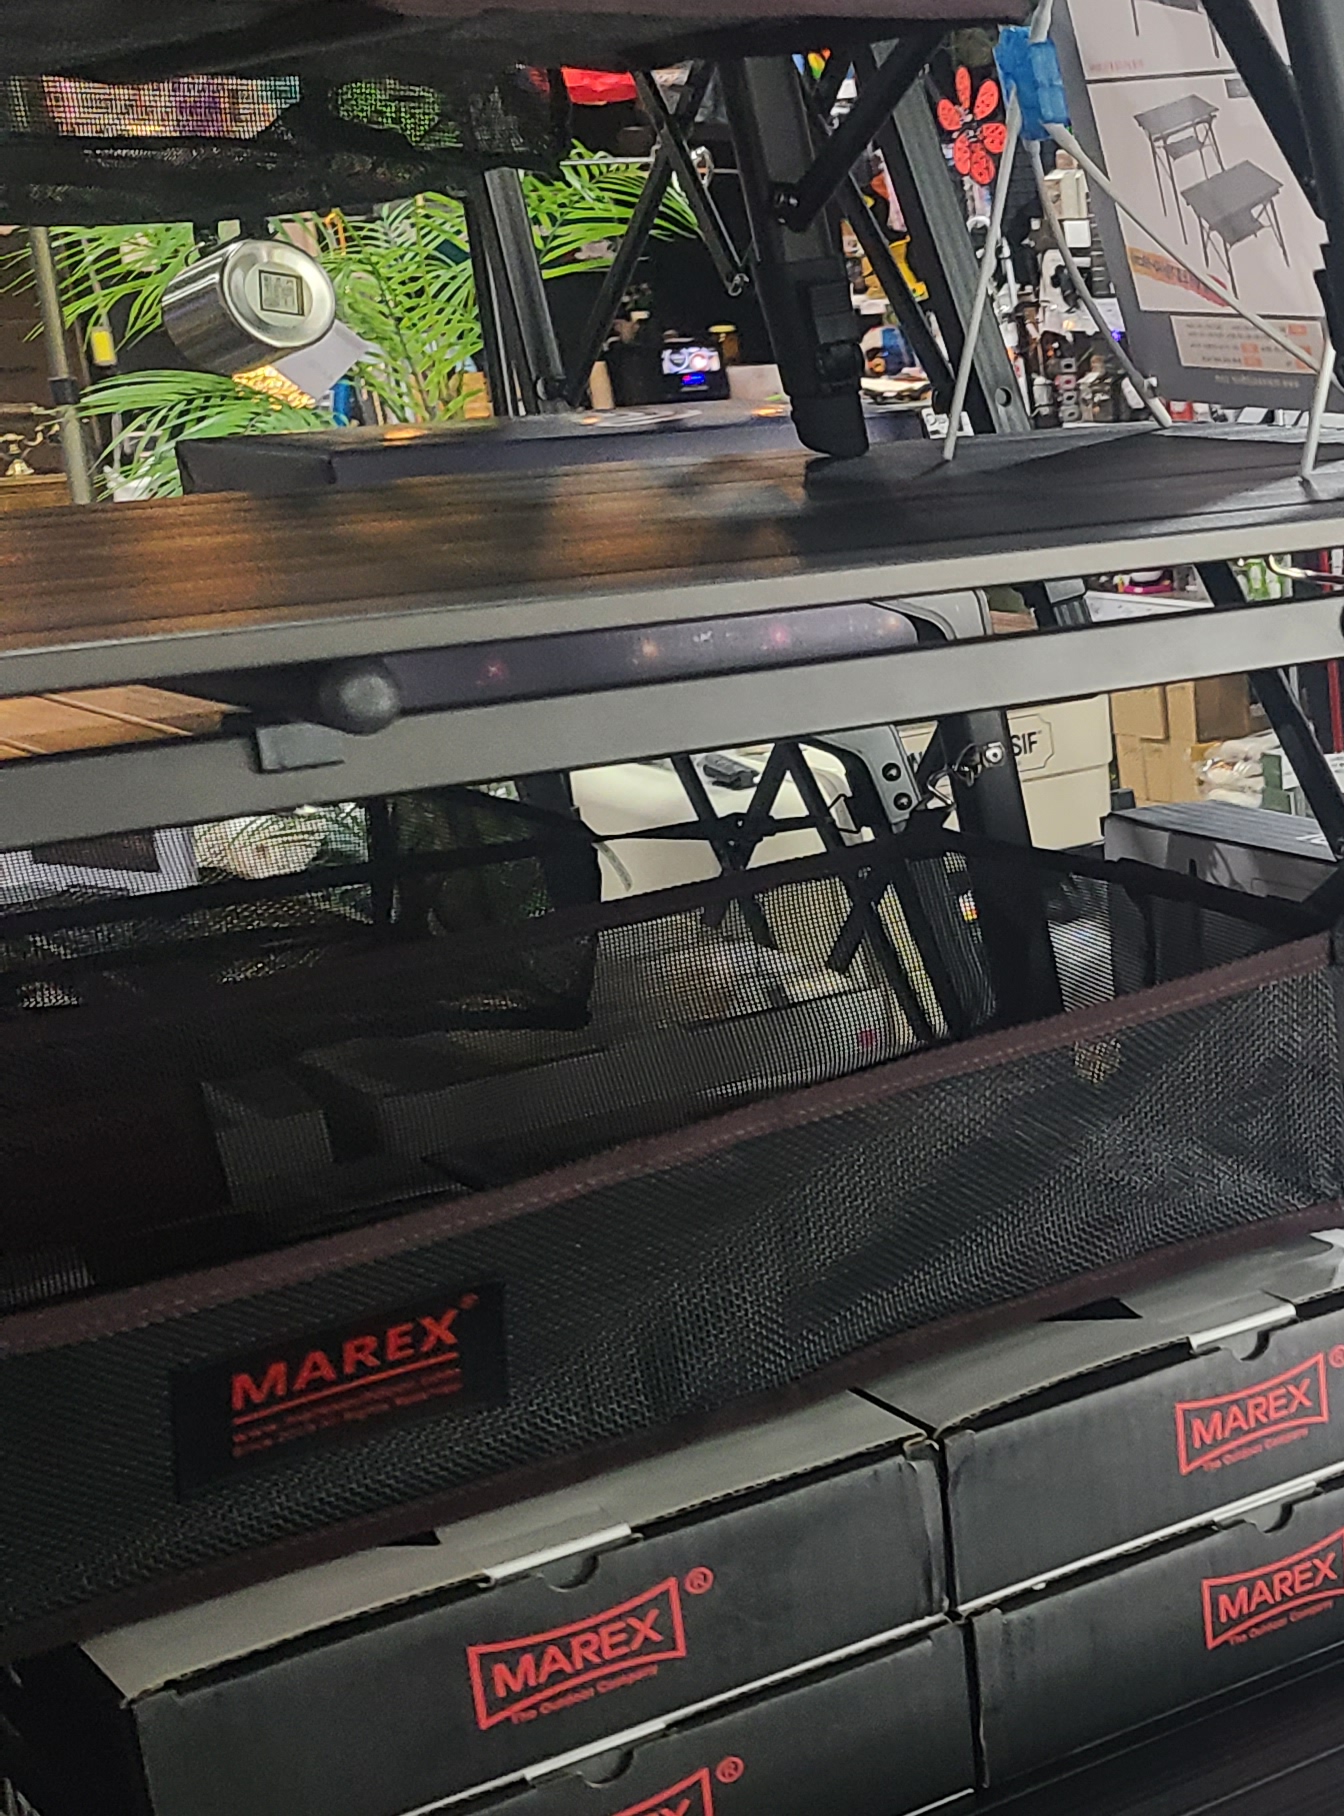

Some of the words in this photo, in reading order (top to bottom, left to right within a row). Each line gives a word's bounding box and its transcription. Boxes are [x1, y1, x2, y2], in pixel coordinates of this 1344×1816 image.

[231, 1308, 460, 1411] MAREX
[1190, 1377, 1313, 1450] MAREX
[1218, 1551, 1338, 1624] MAREX
[490, 1607, 664, 1698] MAREX
